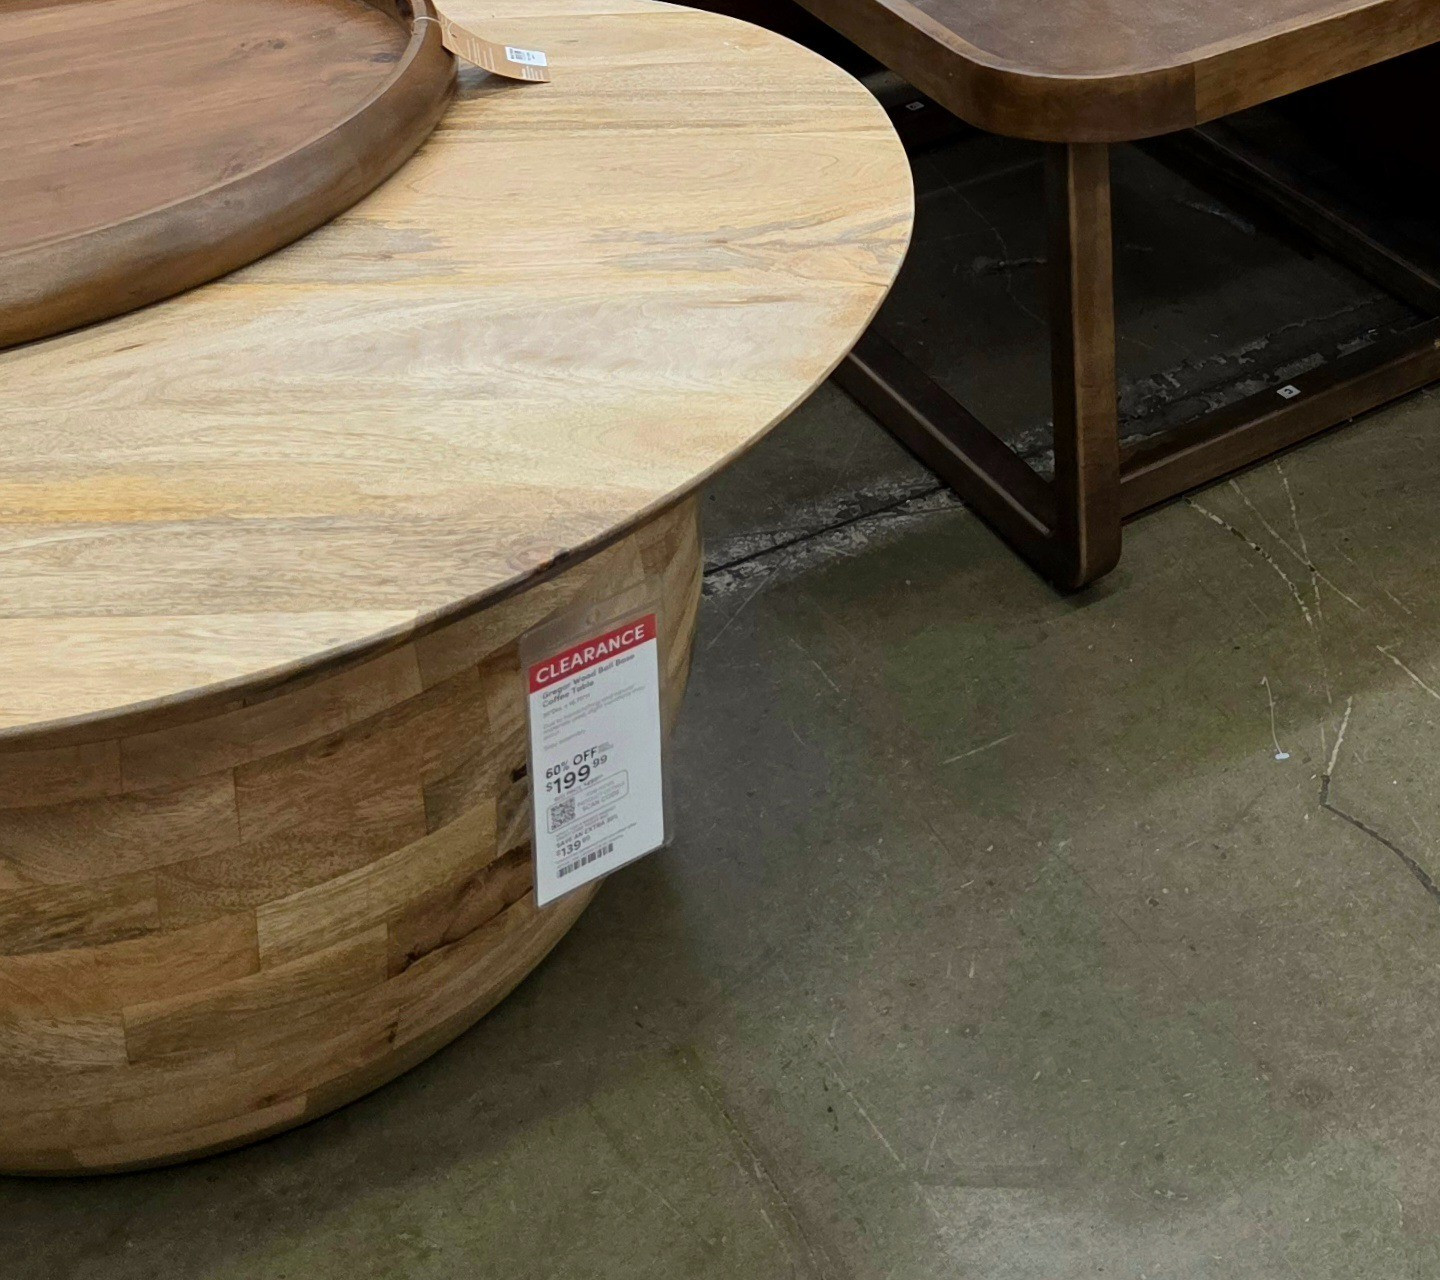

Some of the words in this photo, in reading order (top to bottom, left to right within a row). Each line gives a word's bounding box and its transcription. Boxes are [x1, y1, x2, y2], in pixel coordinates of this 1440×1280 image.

[536, 623, 645, 683] CLEARANCE
[546, 759, 570, 779] 60%
[573, 746, 598, 766] OFF
